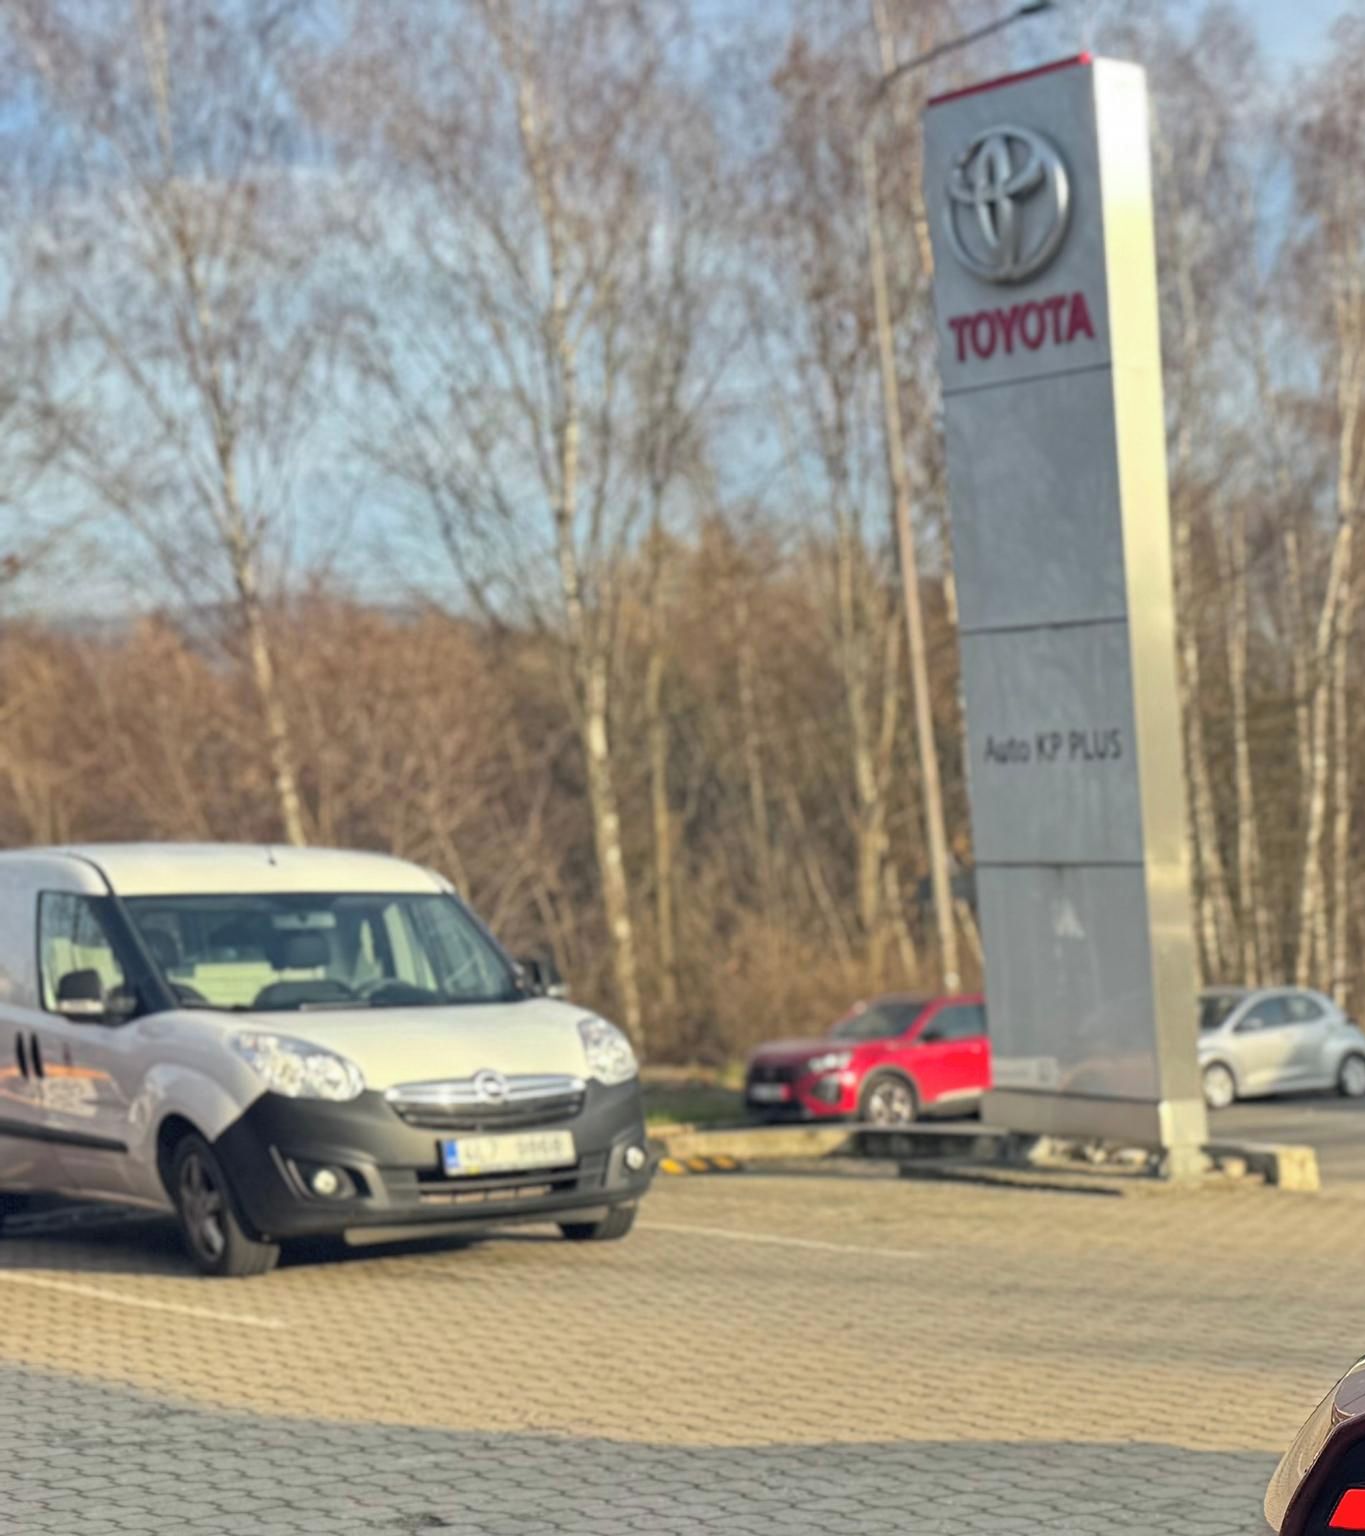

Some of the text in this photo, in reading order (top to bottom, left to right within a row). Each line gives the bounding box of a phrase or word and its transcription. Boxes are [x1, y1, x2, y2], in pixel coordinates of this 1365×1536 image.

[948, 292, 1095, 363] TOYOTA
[984, 728, 1123, 764] Auto KP PLUS
